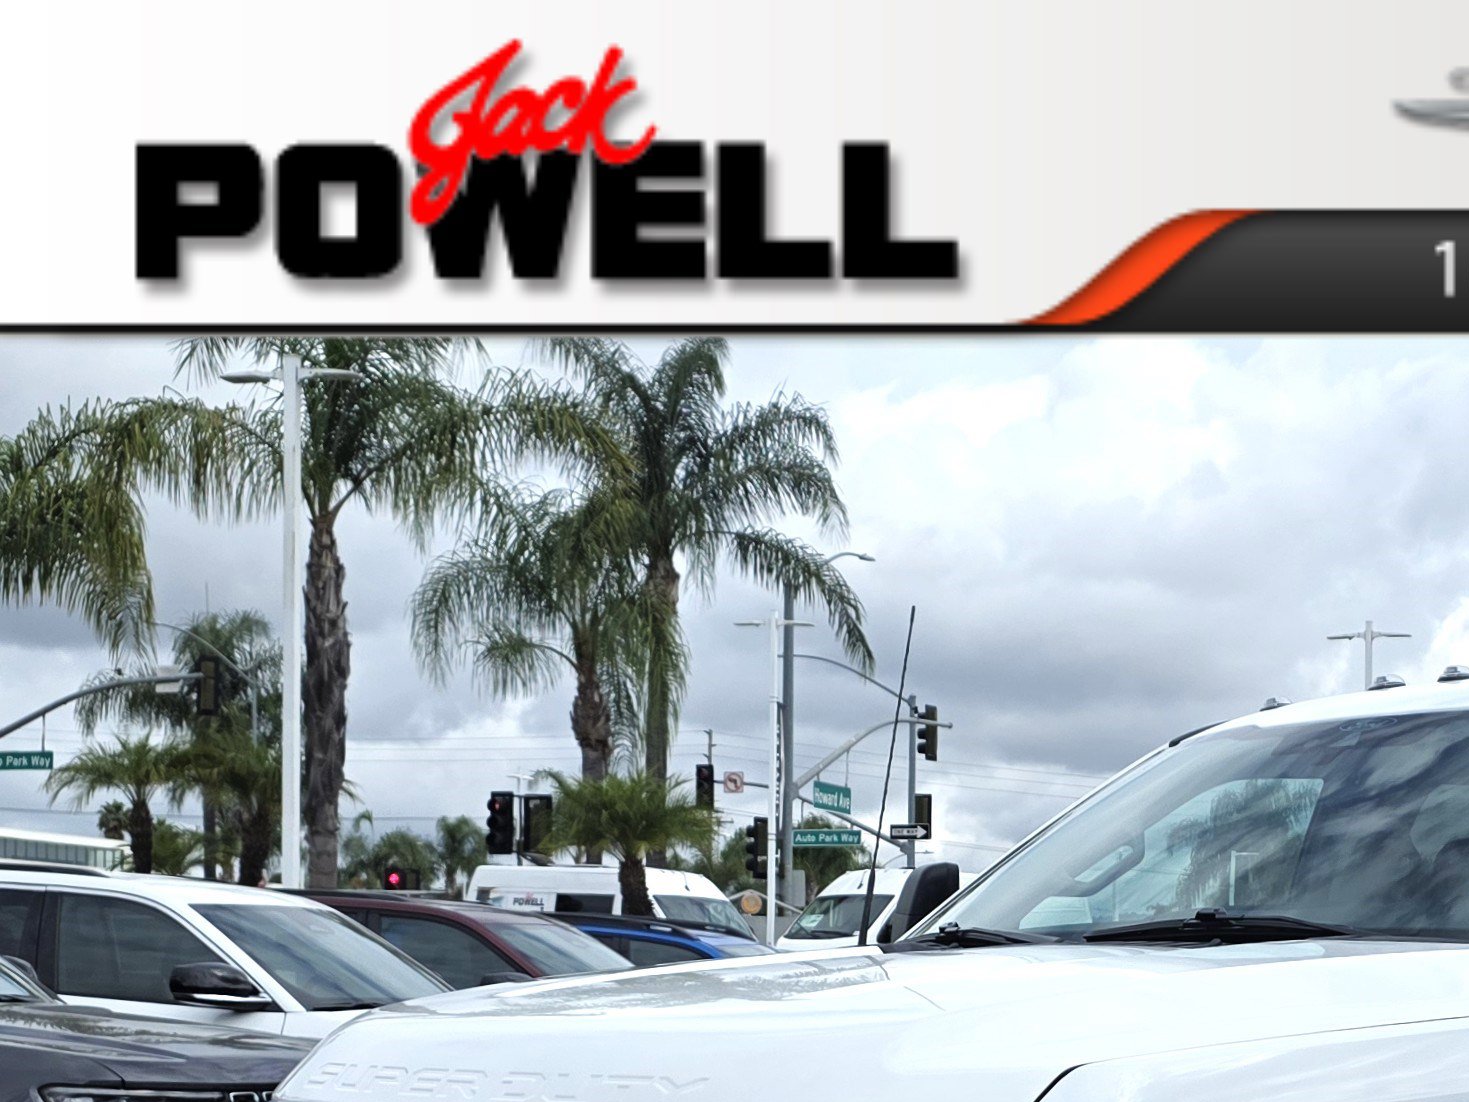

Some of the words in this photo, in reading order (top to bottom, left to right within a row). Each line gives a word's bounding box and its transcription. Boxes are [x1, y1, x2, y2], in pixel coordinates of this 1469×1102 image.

[6, 755, 28, 766] Park
[31, 755, 51, 767] Way
[795, 834, 817, 843] Auto
[820, 833, 839, 842] Park
[842, 833, 860, 844] Way
[303, 1062, 488, 1099] SUPER
